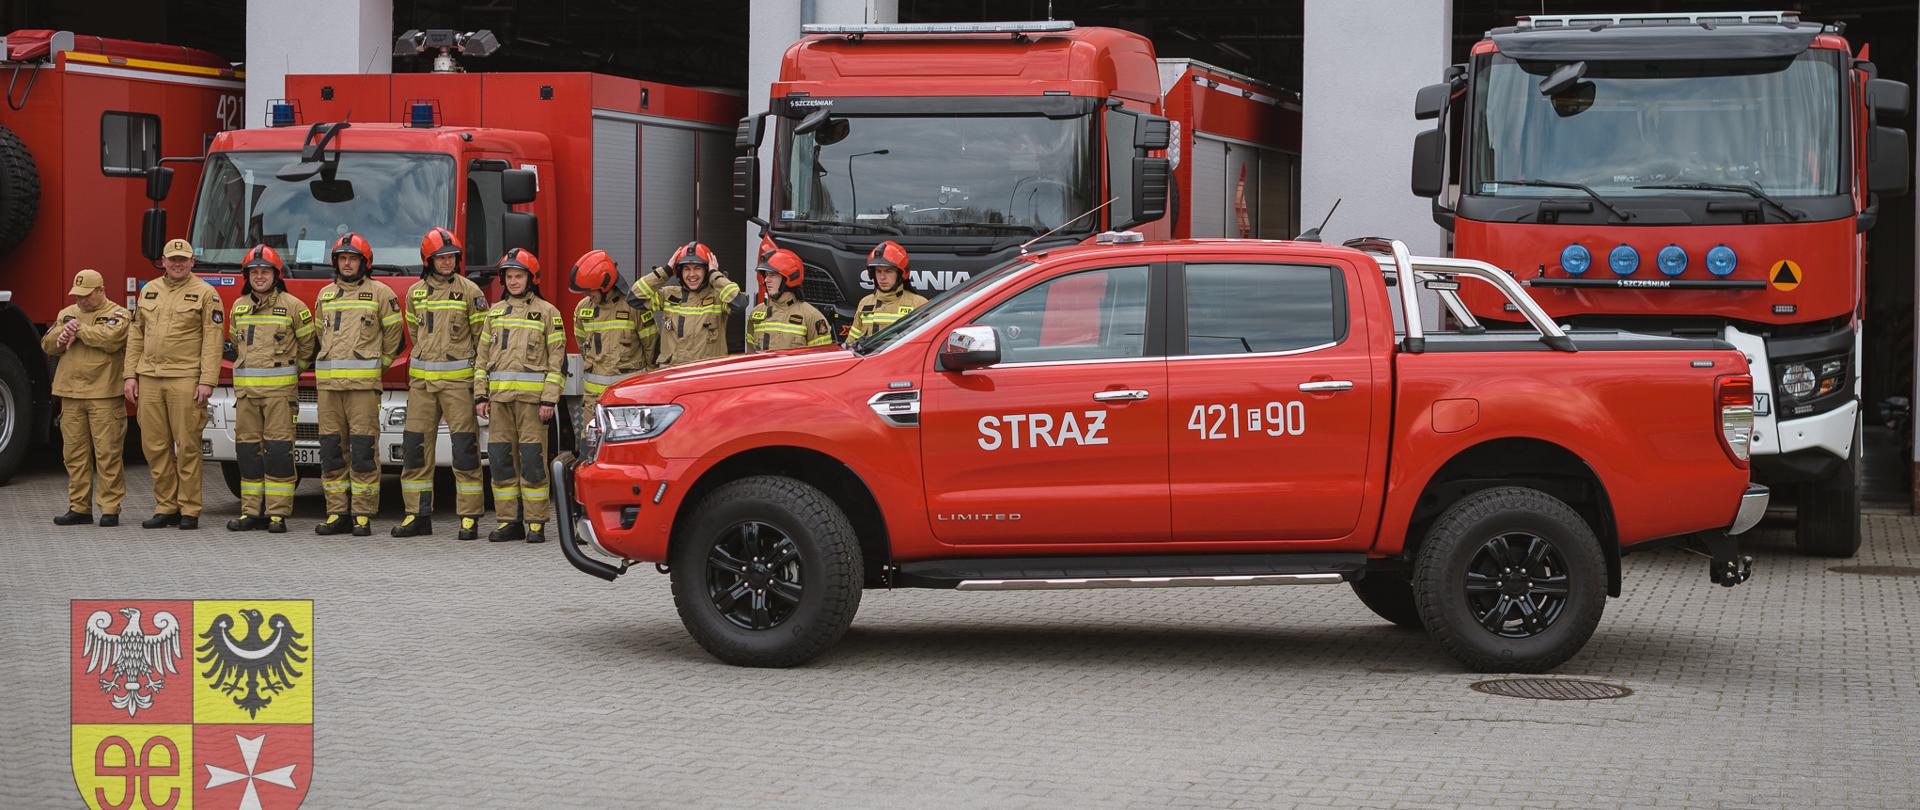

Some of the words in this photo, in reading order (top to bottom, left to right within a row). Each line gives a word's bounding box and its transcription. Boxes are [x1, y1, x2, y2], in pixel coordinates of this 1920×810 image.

[216, 94, 243, 130] 421
[860, 269, 970, 290] SANIA
[977, 410, 1109, 451] STRAŻ
[937, 513, 1022, 521] LIMITED
